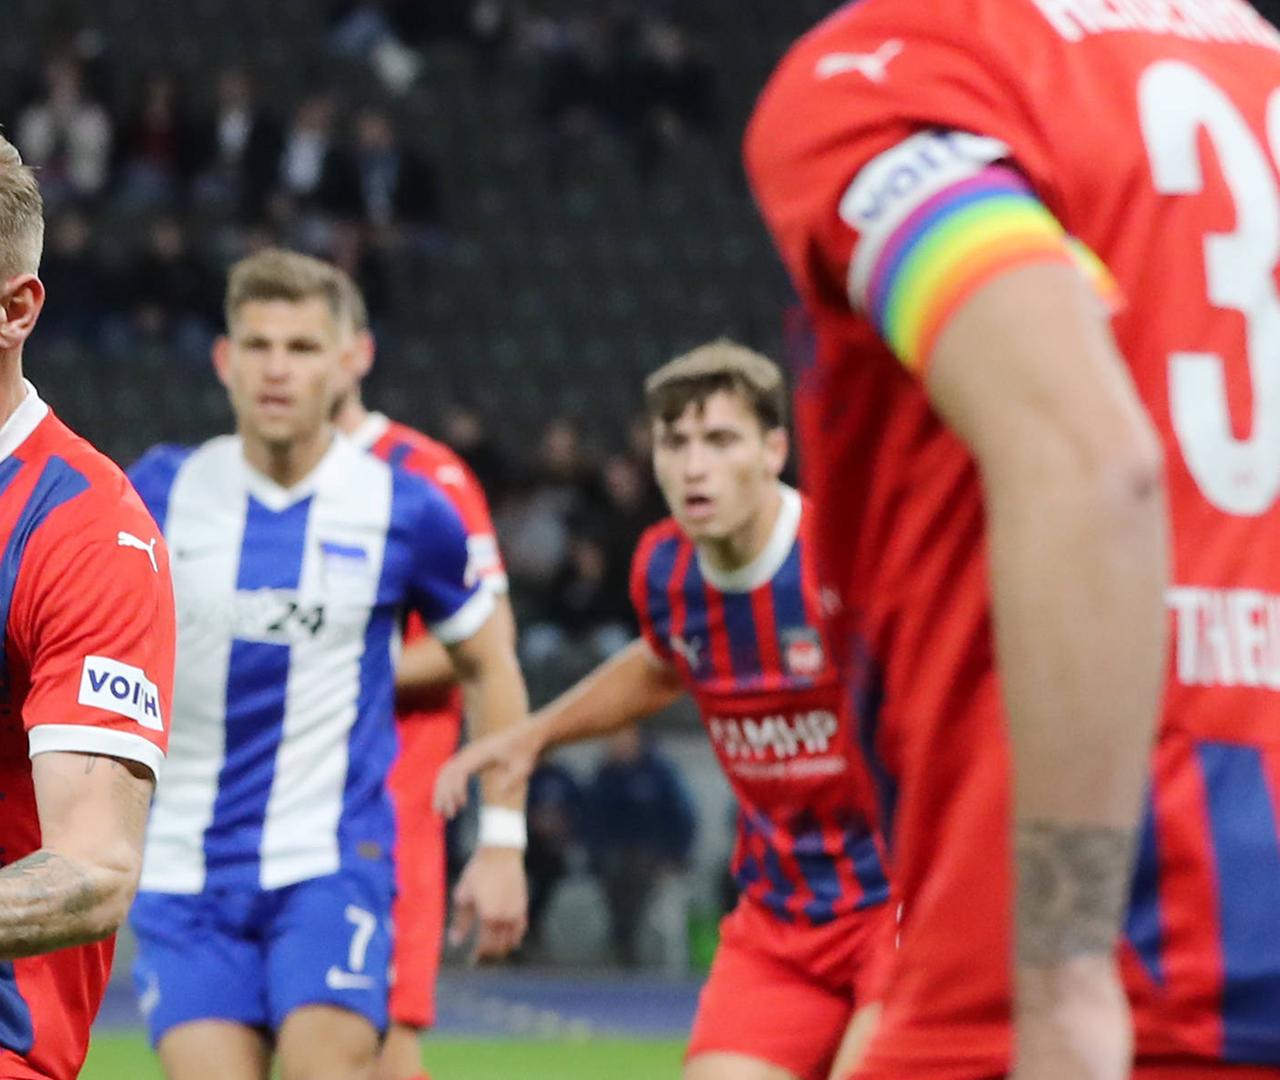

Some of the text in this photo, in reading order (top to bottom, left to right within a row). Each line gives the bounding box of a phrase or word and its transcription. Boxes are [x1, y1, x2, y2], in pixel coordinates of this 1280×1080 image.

[1138, 60, 1280, 517] 3
[87, 668, 158, 718] VOIH
[344, 904, 378, 973] 7
